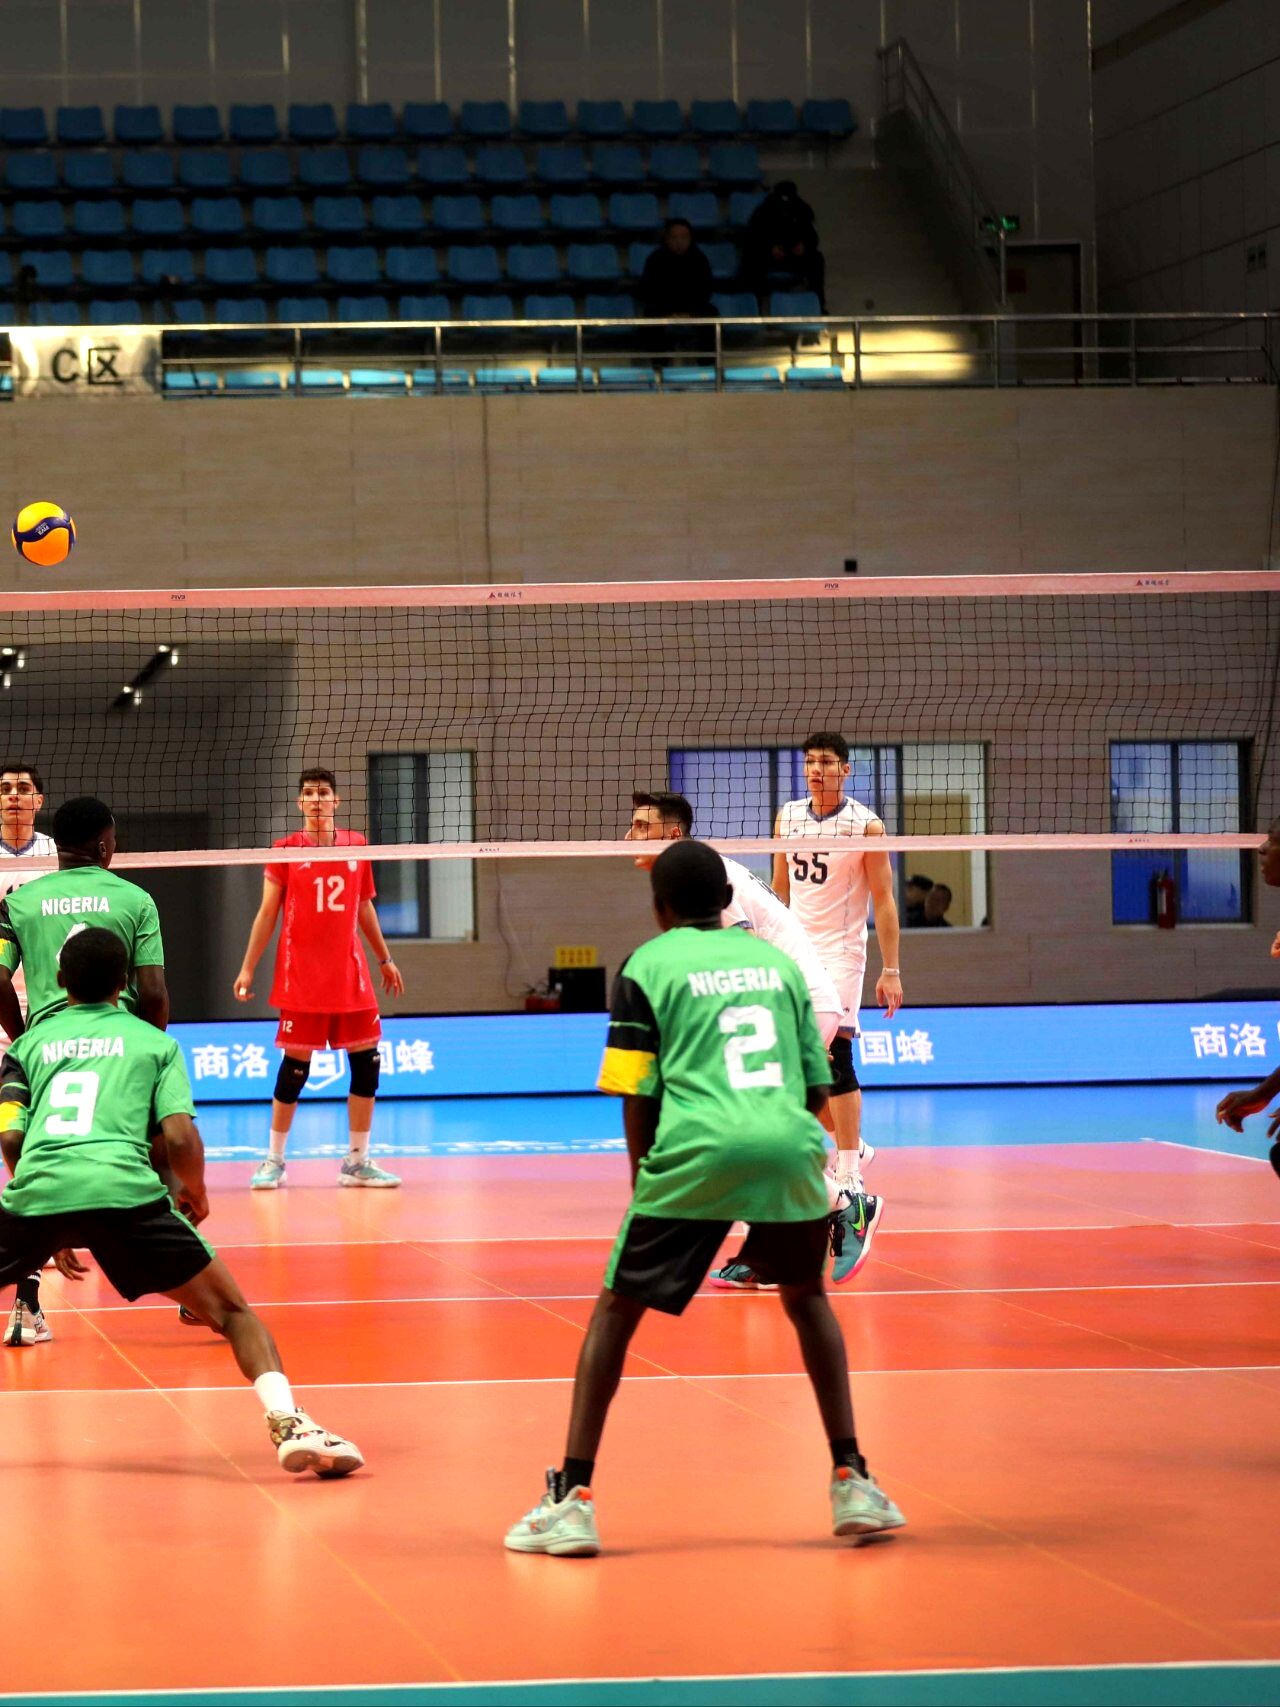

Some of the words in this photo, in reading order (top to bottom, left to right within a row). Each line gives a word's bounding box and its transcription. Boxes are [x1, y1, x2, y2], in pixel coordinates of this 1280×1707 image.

[41, 896, 110, 917] NIGERIA
[313, 875, 346, 913] 12
[687, 967, 784, 997] NIGERIA
[282, 1020, 293, 1033] 12
[1190, 1022, 1267, 1059] 商洛
[42, 1036, 124, 1065] NIGERIA
[192, 1043, 270, 1080] 商洛
[718, 1004, 784, 1090] 2
[859, 1029, 935, 1066] 国蜂
[45, 1071, 100, 1136] 9
